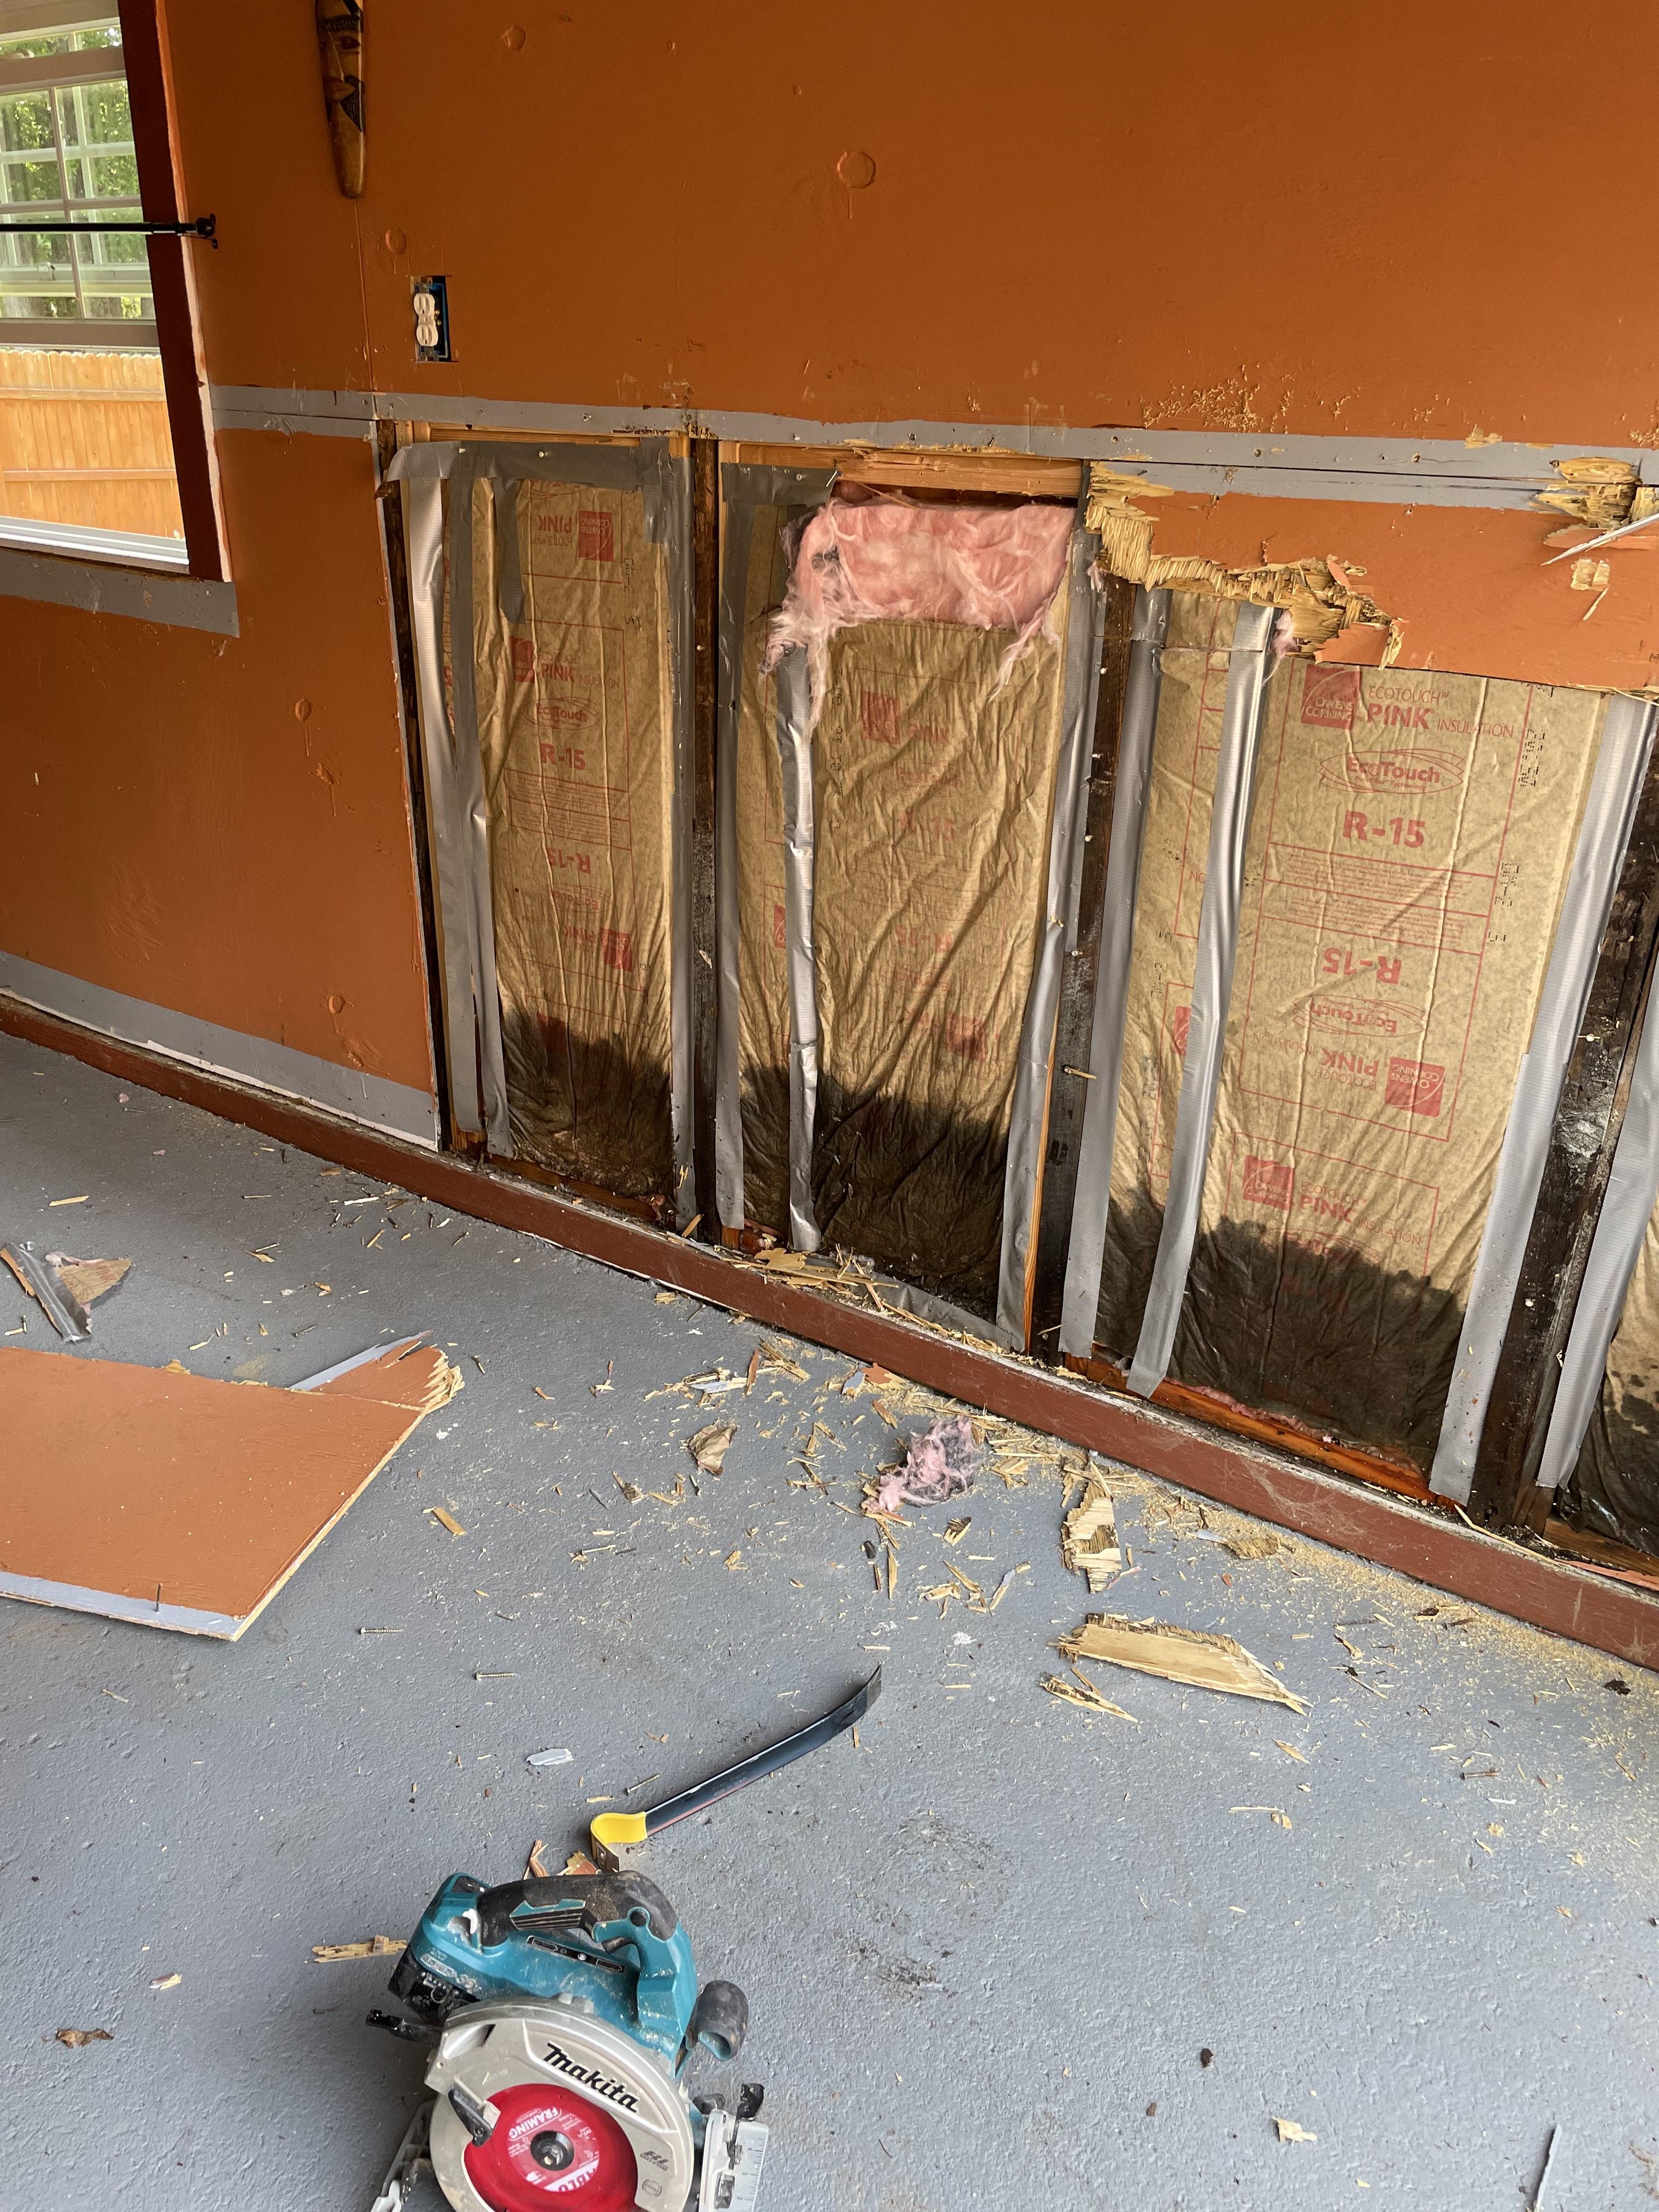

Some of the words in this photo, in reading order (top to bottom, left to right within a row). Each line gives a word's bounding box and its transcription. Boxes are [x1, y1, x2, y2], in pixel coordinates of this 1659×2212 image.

[536, 514, 572, 533] PINK
[541, 663, 574, 682] PINK
[578, 673, 620, 689] INSULAION
[1305, 706, 1352, 722] CORNING
[1316, 696, 1354, 710] OWENS
[1367, 702, 1431, 730] PINK
[1437, 718, 1514, 738] INSULATION
[540, 742, 586, 771] R-15
[1346, 756, 1441, 783] EcoTouch
[1342, 809, 1425, 848] R-15
[1322, 947, 1402, 985] R-15
[1310, 1003, 1397, 1034] EcoTouch
[1252, 1032, 1315, 1056] INSULATION
[1321, 1048, 1379, 1077] PINK
[1299, 1194, 1353, 1223] PINK
[1357, 1218, 1421, 1246] INSULATION
[509, 2107, 560, 2138] FRAMING
